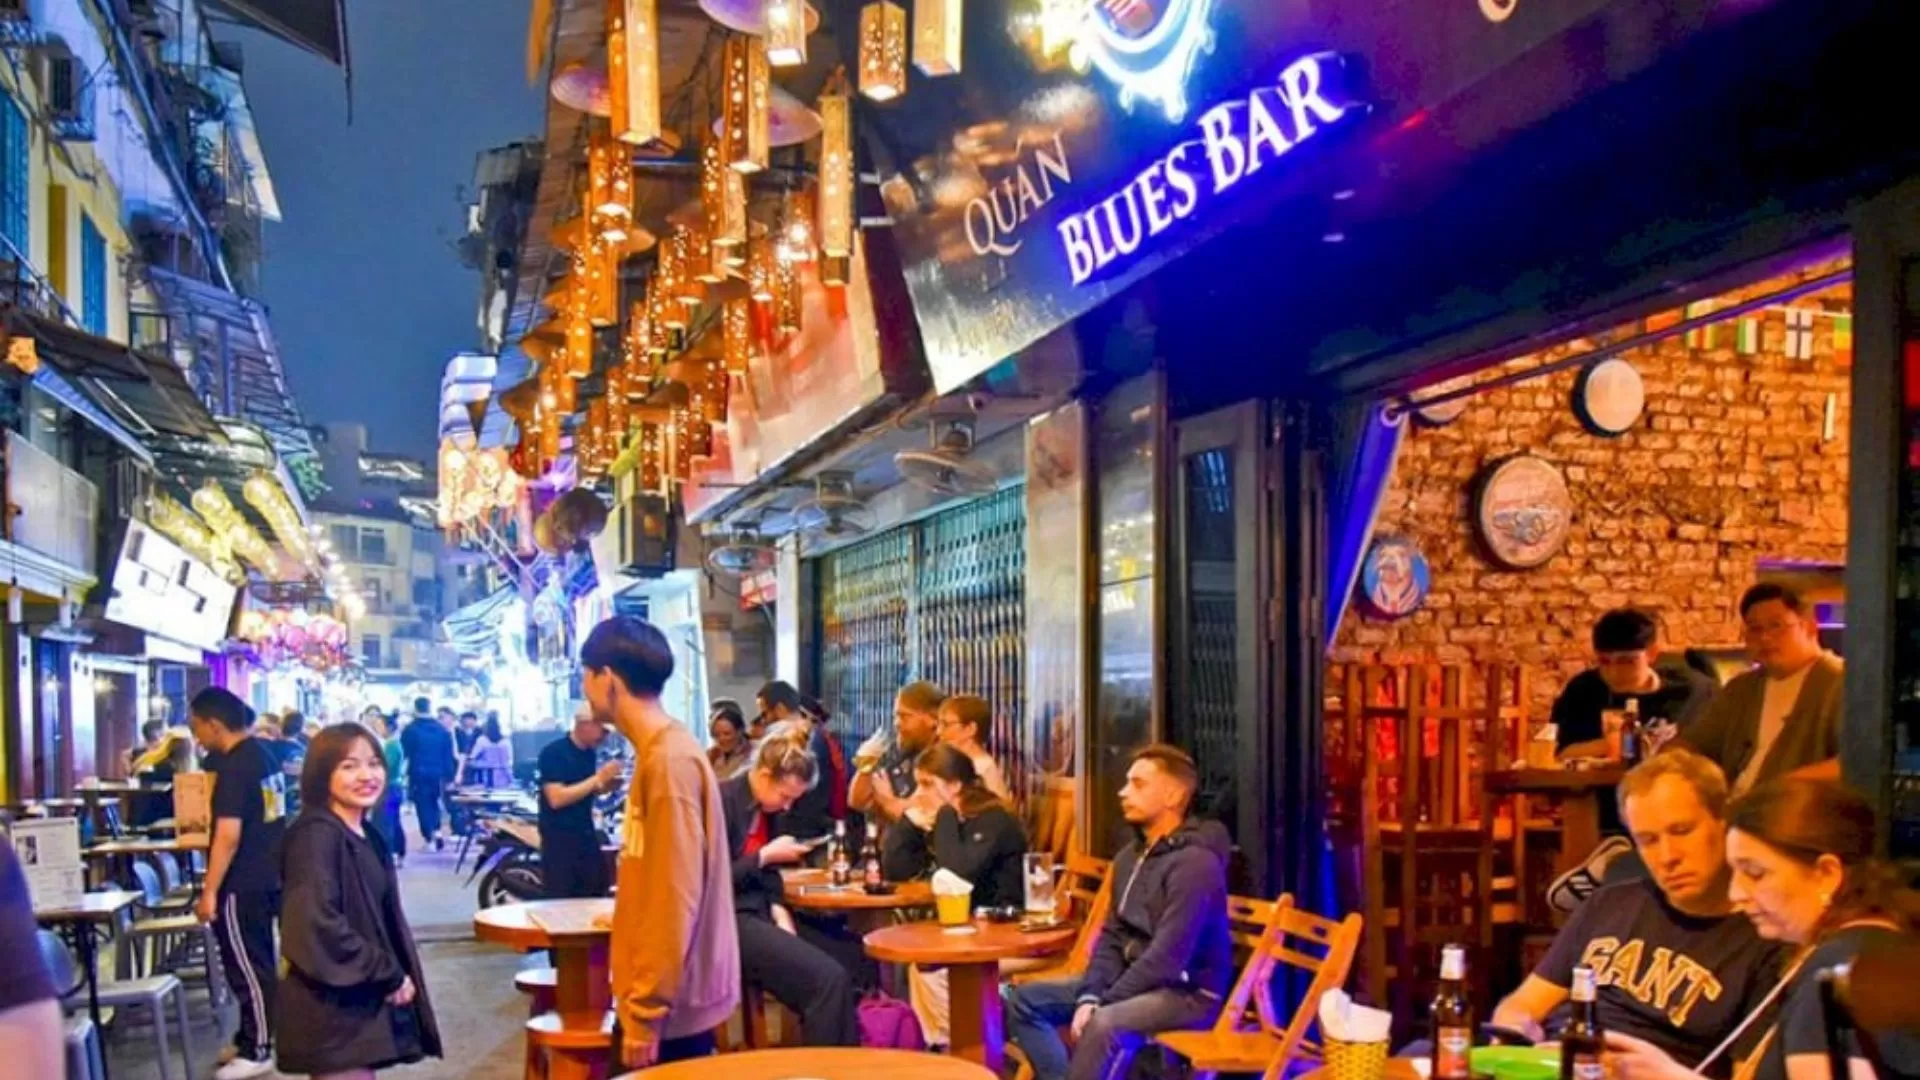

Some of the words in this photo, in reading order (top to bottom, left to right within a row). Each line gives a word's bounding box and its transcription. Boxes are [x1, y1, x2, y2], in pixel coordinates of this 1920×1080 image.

[1057, 146, 1198, 287] BLUES
[1198, 56, 1345, 194] BAR
[1581, 936, 1723, 1027] GANT
